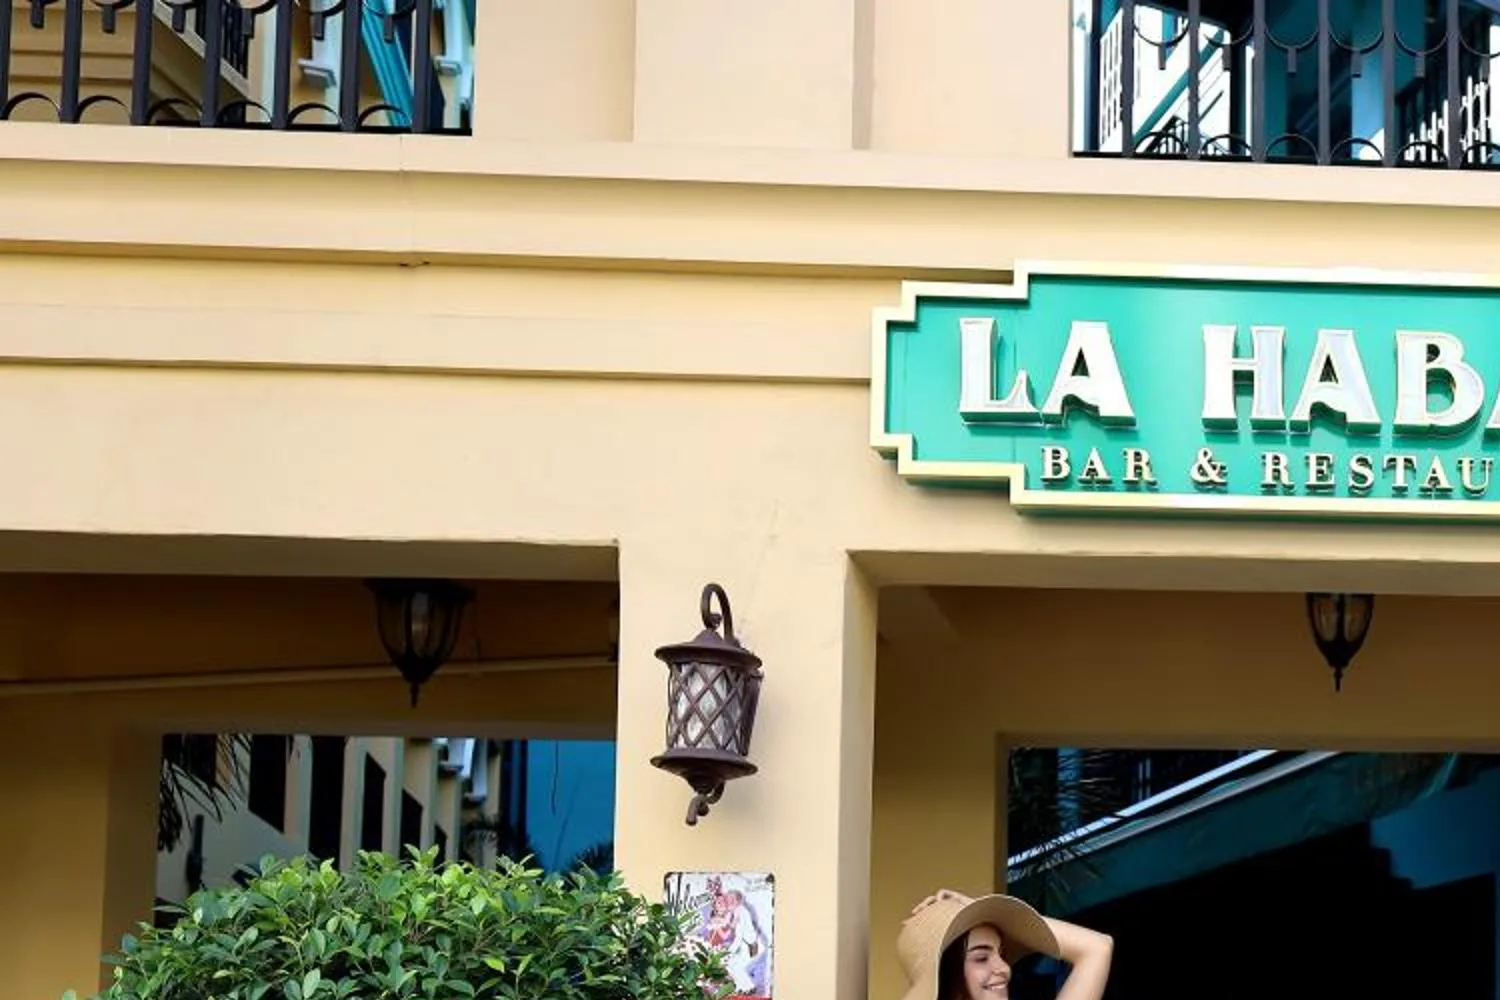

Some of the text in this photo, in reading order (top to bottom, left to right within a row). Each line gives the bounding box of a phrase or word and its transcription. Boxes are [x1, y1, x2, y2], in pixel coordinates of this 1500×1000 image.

[959, 317, 1137, 427] LA
[1040, 446, 1157, 485] BAR
[1190, 448, 1228, 486] &
